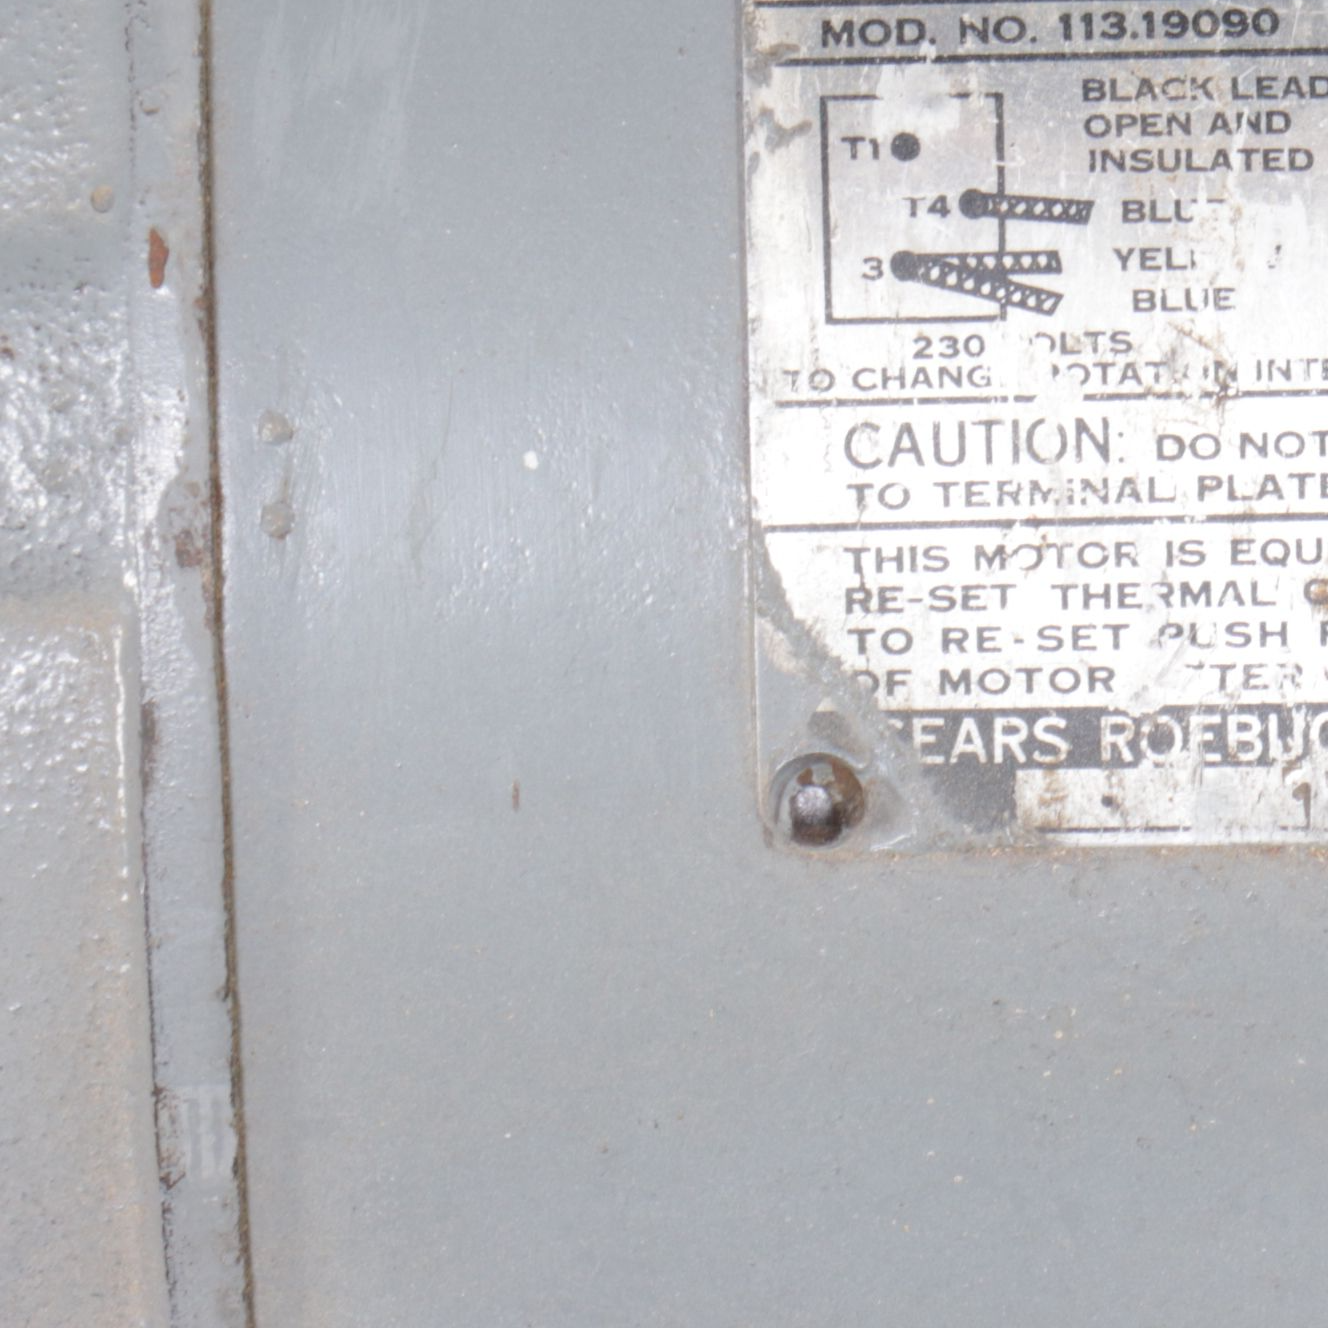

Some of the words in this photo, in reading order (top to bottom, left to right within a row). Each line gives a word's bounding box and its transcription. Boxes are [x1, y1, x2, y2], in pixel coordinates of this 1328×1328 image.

[821, 18, 936, 48] MOD.
[960, 15, 1036, 44] NO.
[1059, 8, 1279, 40] 113.19090
[1083, 75, 1213, 102] BLACK
[1084, 112, 1192, 138] OPEN
[1210, 111, 1291, 135] AND
[841, 137, 880, 161] T1
[1089, 148, 1314, 172] INSULATED
[905, 195, 950, 219] T4
[1121, 199, 1226, 223] BLU
[1132, 287, 1236, 313] BLUE
[913, 334, 984, 359] 230
[1029, 329, 1133, 356] OLTS
[784, 369, 835, 393] TO
[852, 365, 994, 391] CHANG
[844, 415, 1126, 470] CAUTION:
[1156, 433, 1221, 463] DO
[847, 482, 910, 511] TO
[940, 475, 1177, 509] TERMINAL
[844, 545, 950, 575] THIS
[975, 541, 1141, 572] MOTOR
[1166, 540, 1206, 568] IS
[844, 583, 1016, 615] RE-SET
[1051, 580, 1277, 611] THERMAL
[847, 627, 913, 656] TO
[1158, 621, 1288, 650] PUSH
[939, 665, 1116, 695] MOTOR
[885, 715, 1072, 766] EARS
